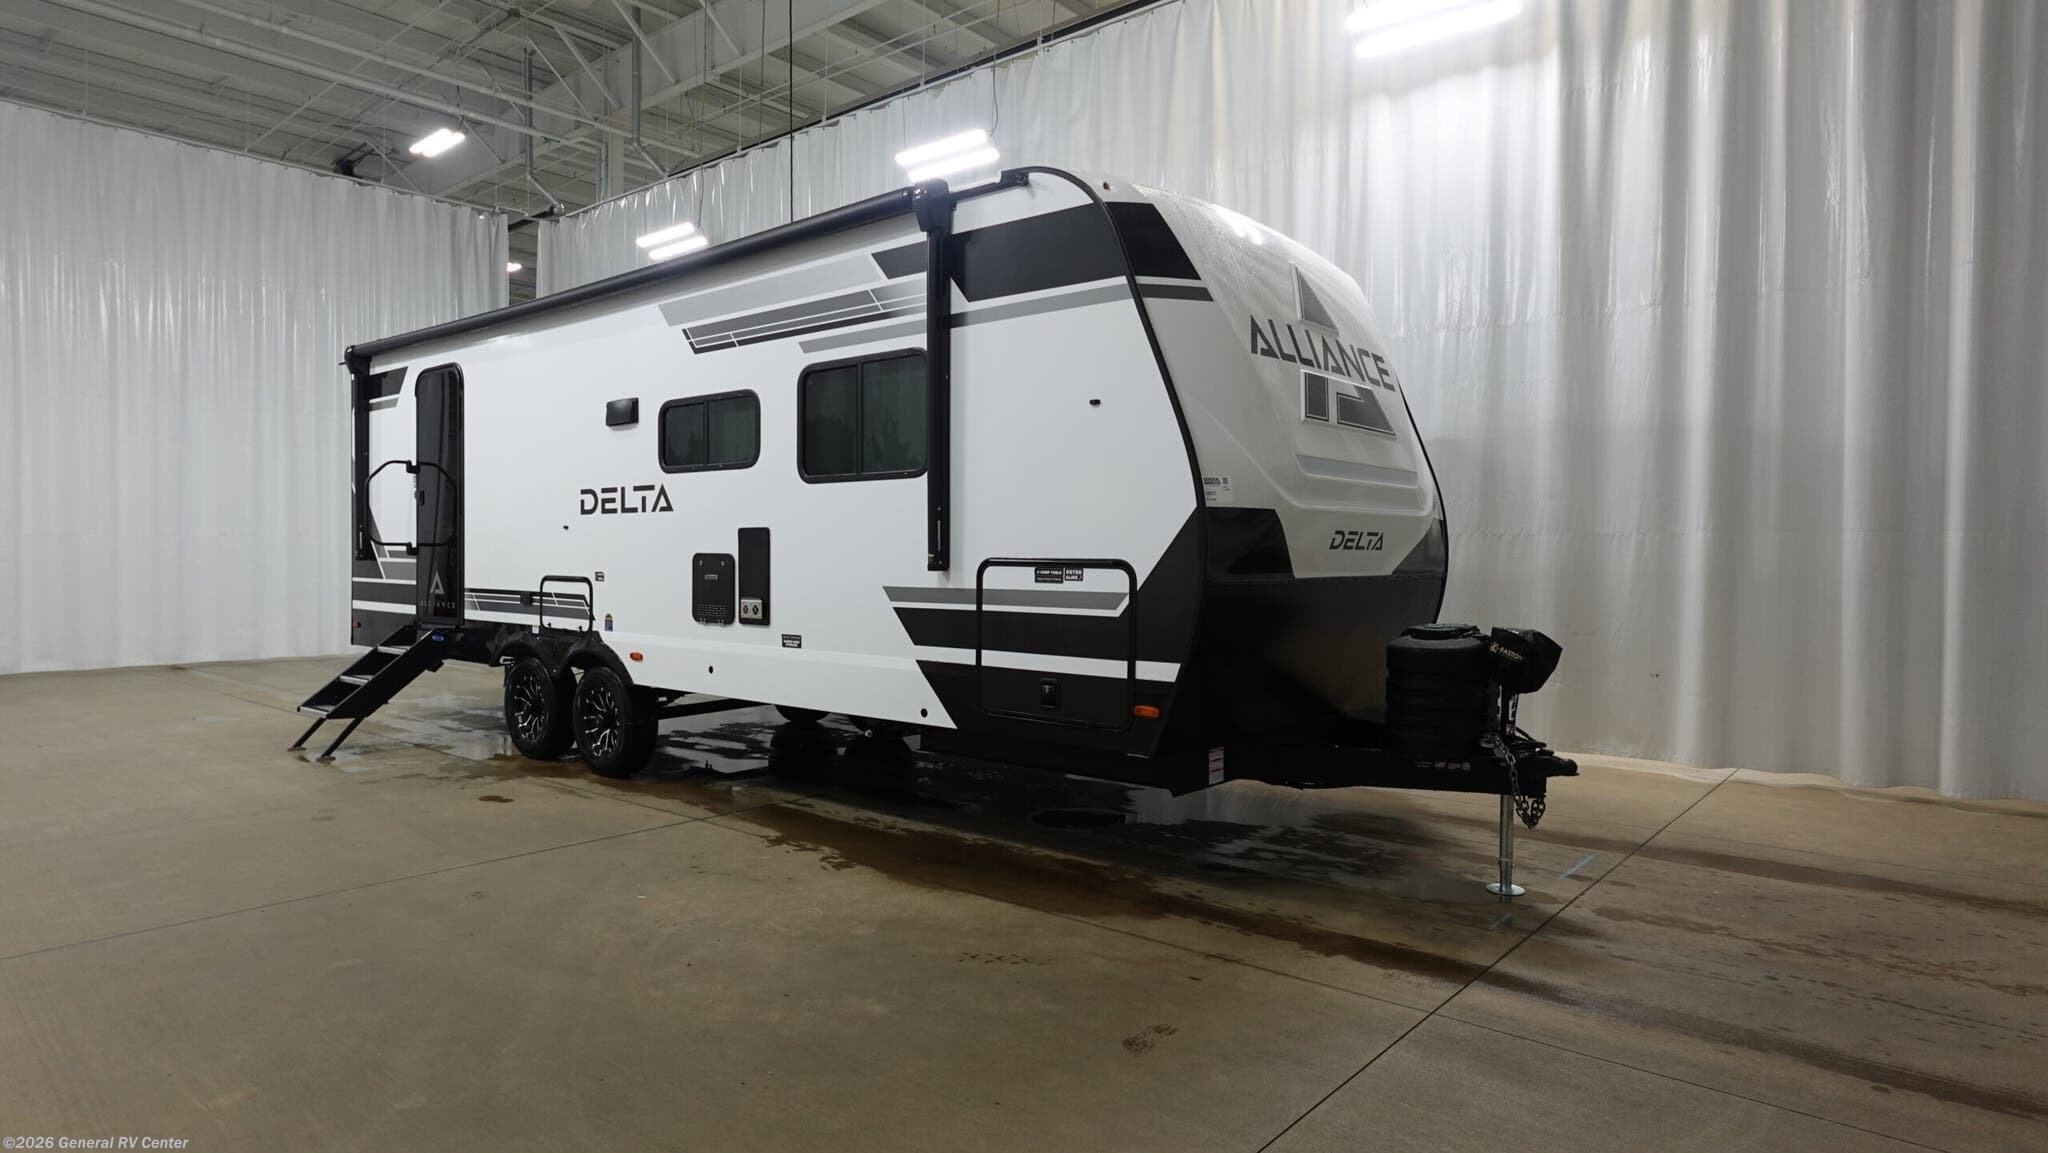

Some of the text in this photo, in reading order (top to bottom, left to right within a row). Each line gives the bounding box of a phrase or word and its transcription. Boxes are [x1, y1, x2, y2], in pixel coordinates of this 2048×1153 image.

[1250, 314, 1396, 392] ALLIANCE
[580, 483, 674, 516] DELTA
[1328, 529, 1384, 551] DELTA
